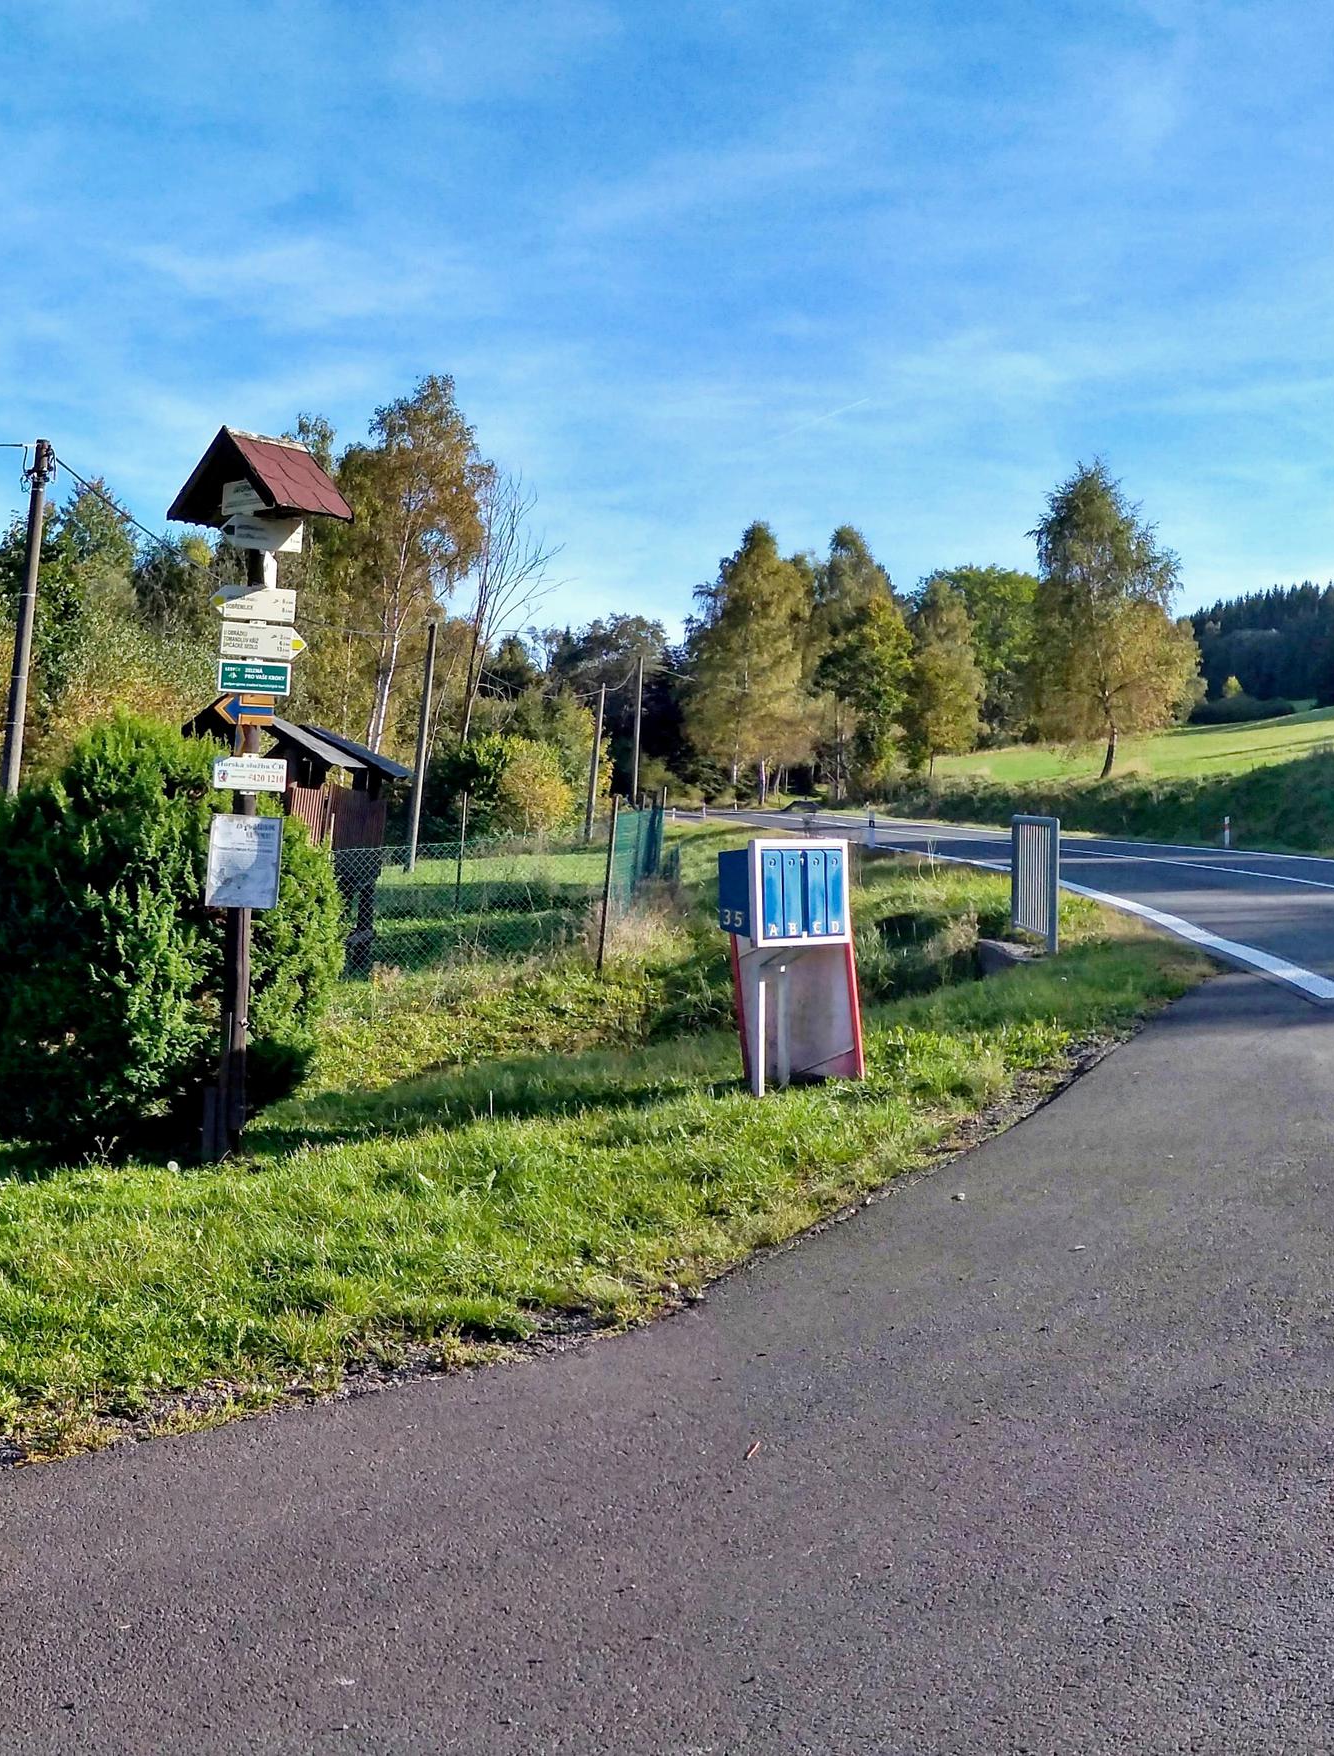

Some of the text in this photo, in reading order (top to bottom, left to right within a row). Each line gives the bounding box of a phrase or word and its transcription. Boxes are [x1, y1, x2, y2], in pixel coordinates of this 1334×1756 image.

[267, 775, 284, 783] 1210
[723, 909, 744, 928] 35
[768, 920, 840, 936] A B C D
